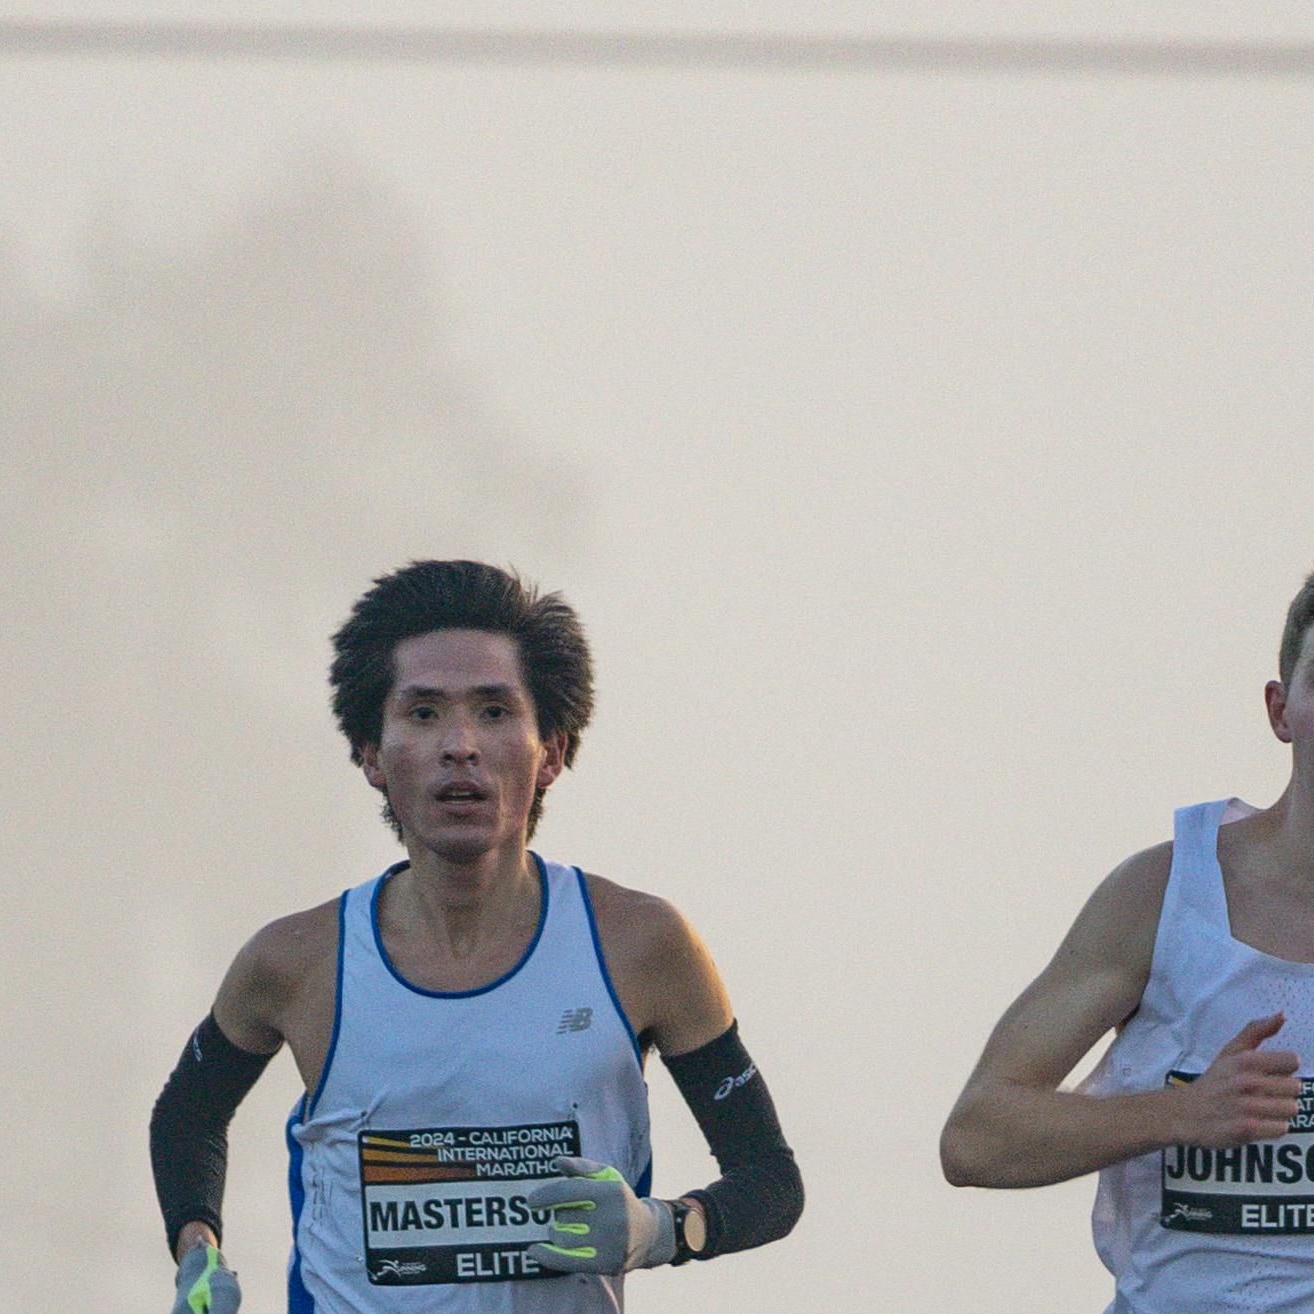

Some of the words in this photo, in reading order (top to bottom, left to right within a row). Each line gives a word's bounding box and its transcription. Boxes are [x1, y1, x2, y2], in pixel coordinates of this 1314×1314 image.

[408, 1132, 456, 1148] 2024
[468, 1126, 574, 1145] CALIFORNIA
[437, 1142, 574, 1163] INTERNATIONAL
[476, 1160, 561, 1177] MARATHO
[455, 1250, 541, 1277] ELITE
